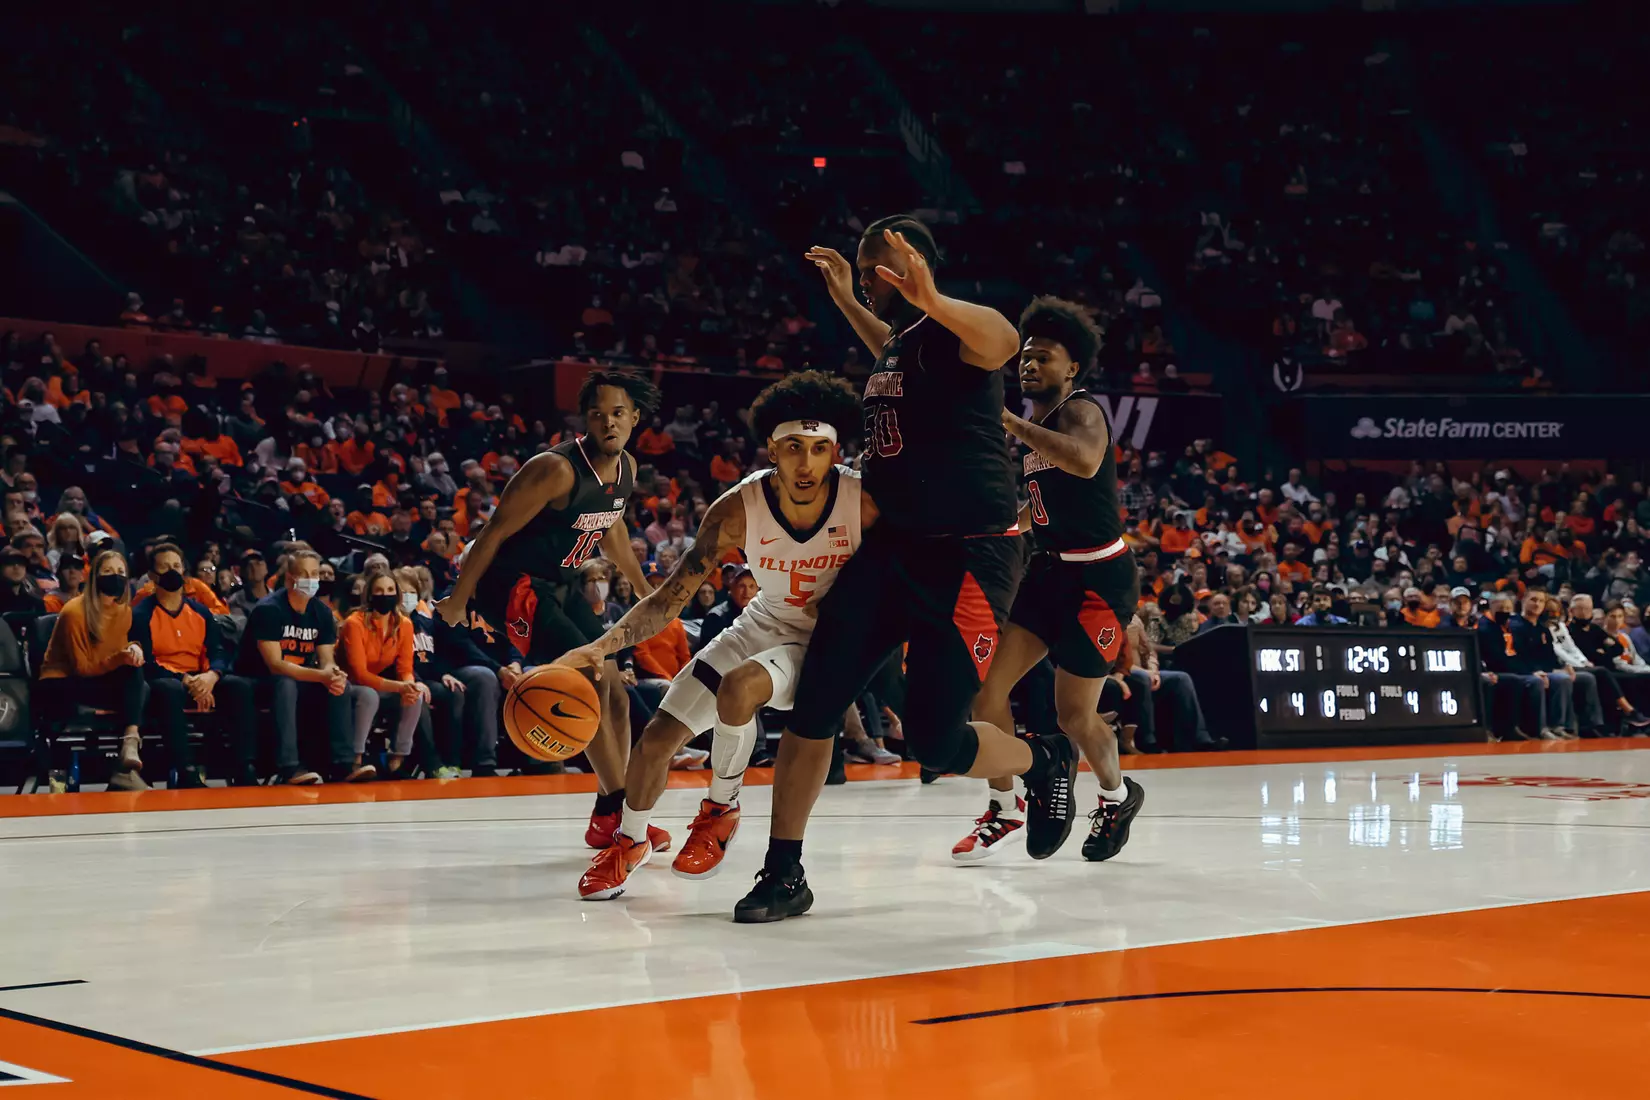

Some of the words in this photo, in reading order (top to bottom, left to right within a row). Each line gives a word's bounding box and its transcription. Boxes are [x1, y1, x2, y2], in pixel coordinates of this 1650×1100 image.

[1493, 422, 1561, 438] CENTER
[759, 553, 852, 573] ILLINOIS
[784, 571, 817, 608] 5
[1285, 649, 1301, 672] ST
[1348, 645, 1390, 673] 12:45
[1291, 692, 1305, 716] 4
[1323, 689, 1336, 718] 8
[1369, 690, 1376, 715] 1
[1406, 690, 1419, 714] 4
[1441, 690, 1458, 715] 16
[528, 724, 576, 756] ELITE
